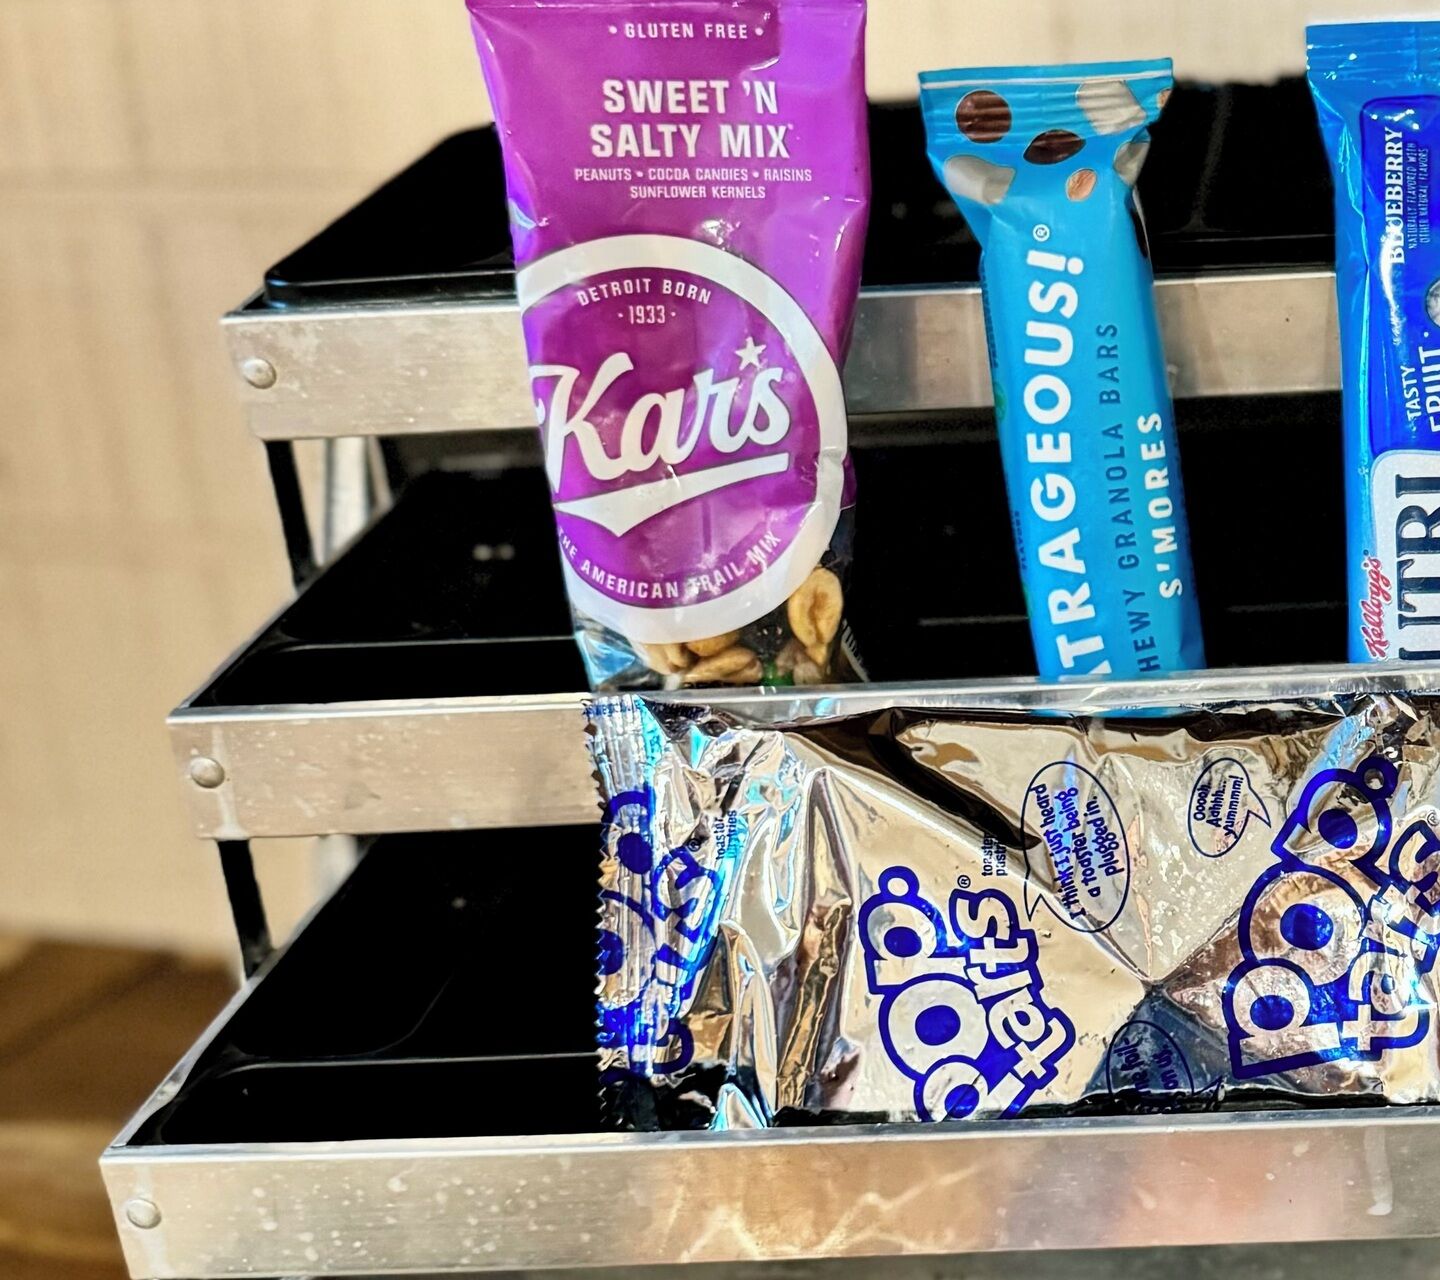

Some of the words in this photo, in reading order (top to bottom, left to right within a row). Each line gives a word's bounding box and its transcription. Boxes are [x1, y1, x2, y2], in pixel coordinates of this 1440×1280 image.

[624, 23, 694, 39] GLUTEN
[704, 23, 748, 39] FREE
[602, 80, 729, 114] SWEET
[590, 124, 701, 158] SALTY
[720, 124, 790, 158] MIX
[574, 168, 632, 181] PEANUTS
[648, 168, 690, 181] COCOA
[695, 168, 748, 181] CANDIES
[763, 168, 812, 181] RAISINS
[630, 185, 707, 199] SUNFLOWER
[711, 185, 766, 199] KERNELS
[1384, 126, 1405, 264] BLUEBERRY
[576, 278, 652, 307] DETROIT
[662, 279, 712, 305] BORN
[628, 305, 667, 324] 1933
[1095, 323, 1120, 405] BARS
[1401, 365, 1424, 421] TASTY
[1104, 422, 1137, 570] GRANOLA
[1136, 412, 1183, 599] S'MORES
[581, 558, 679, 599] AMERICAN
[682, 562, 746, 599] TRAIL
[749, 531, 782, 568] MIX
[1360, 556, 1392, 657] Kellogg's
[1030, 784, 1056, 828] heard
[1054, 787, 1081, 832] being
[1083, 796, 1101, 817] in.
[1043, 828, 1071, 857] just
[1072, 832, 1097, 886] toaster
[1087, 817, 1125, 877] plugged
[1054, 865, 1079, 910] think
[1087, 886, 1101, 898] a
